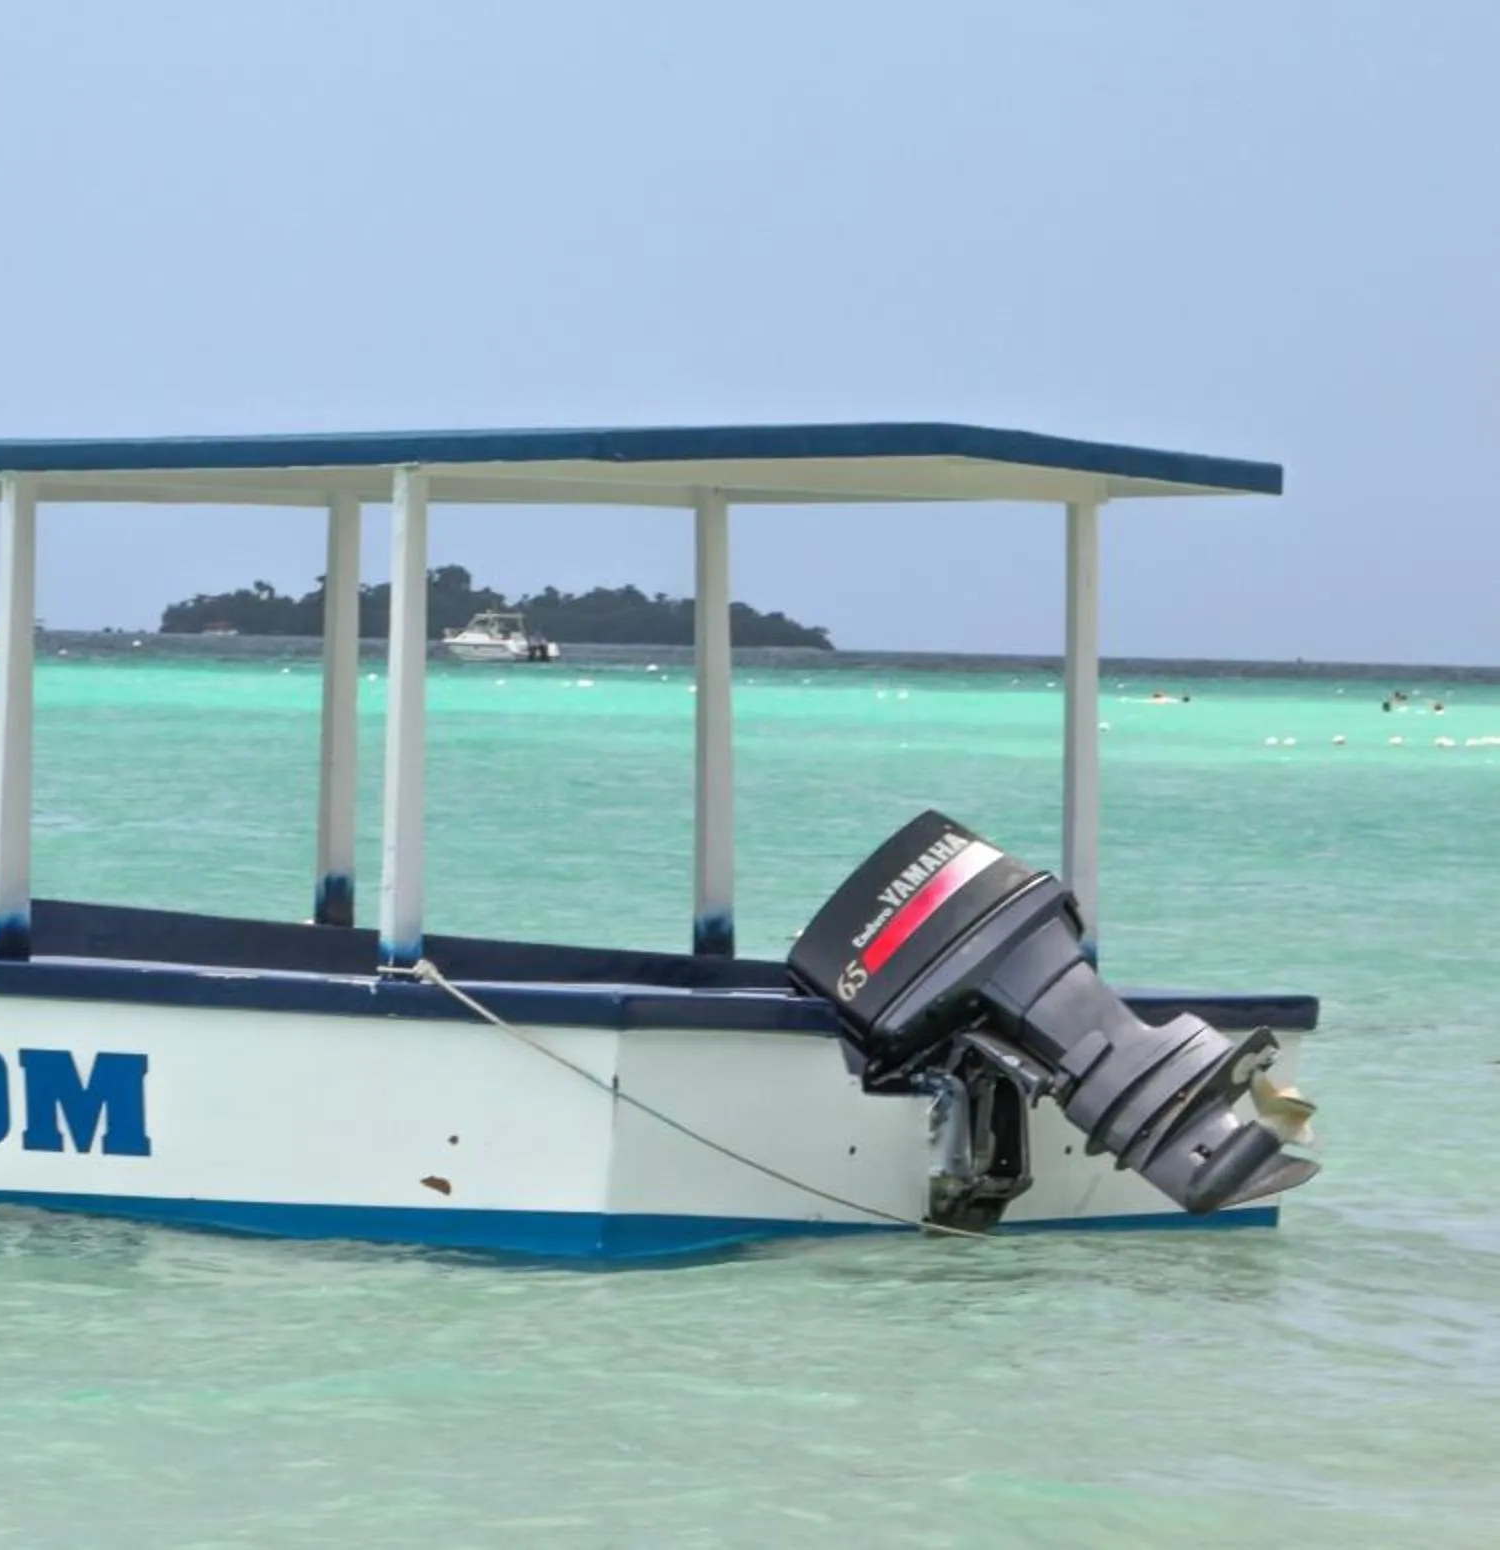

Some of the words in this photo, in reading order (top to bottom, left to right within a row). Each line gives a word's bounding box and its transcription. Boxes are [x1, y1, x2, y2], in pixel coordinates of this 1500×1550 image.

[852, 907, 894, 948] Enduro
[877, 832, 969, 907] YAMAHA
[837, 960, 868, 1001] 65
